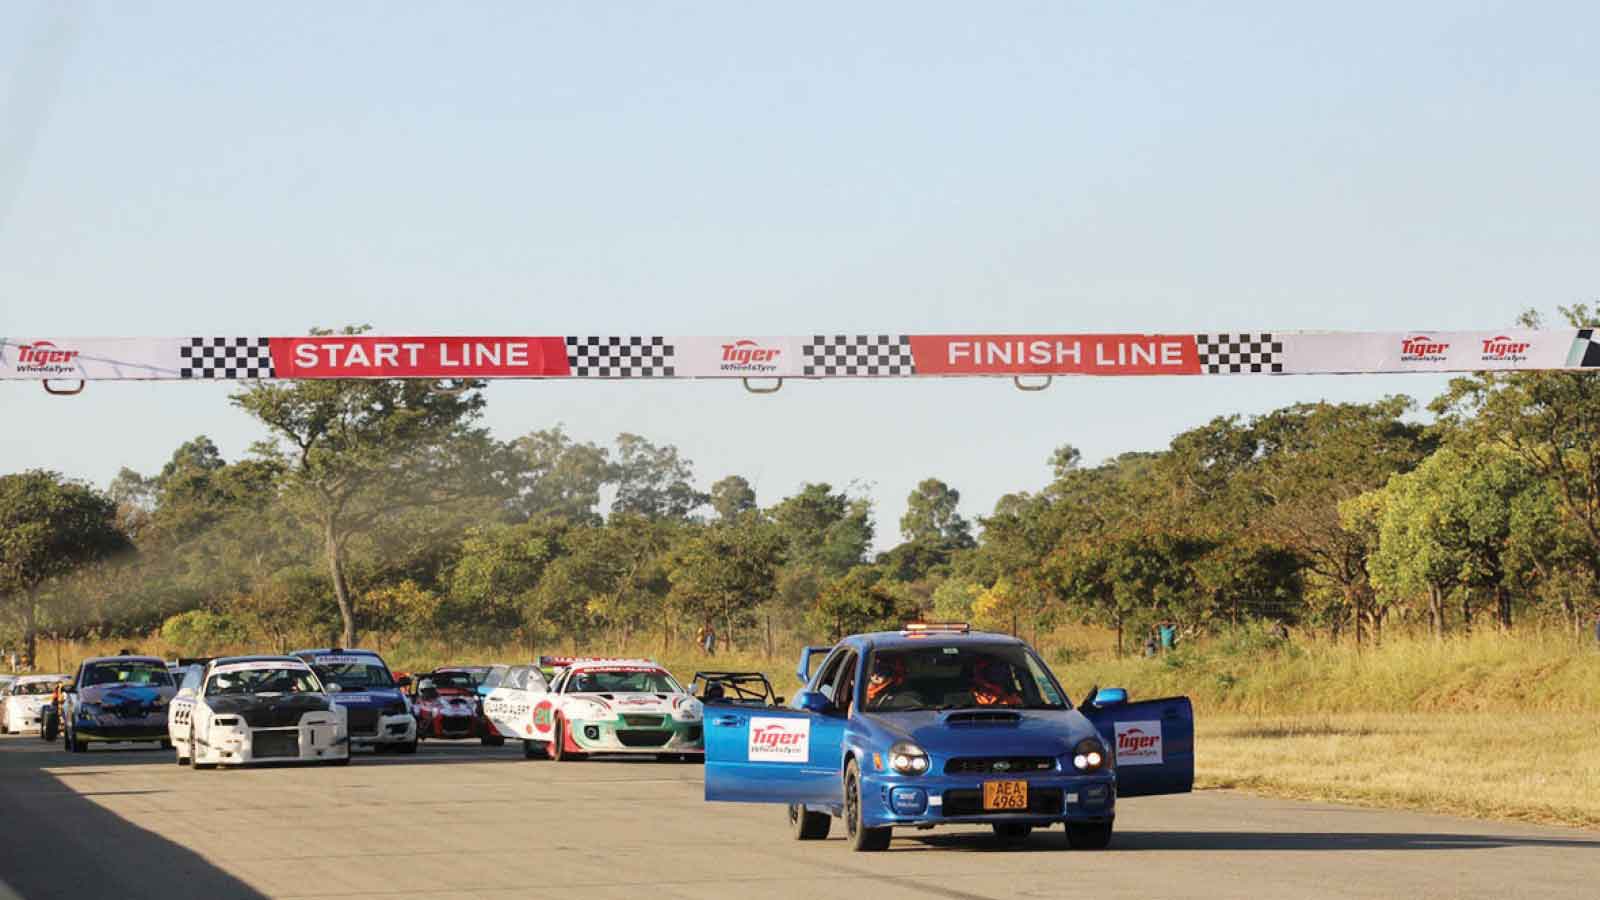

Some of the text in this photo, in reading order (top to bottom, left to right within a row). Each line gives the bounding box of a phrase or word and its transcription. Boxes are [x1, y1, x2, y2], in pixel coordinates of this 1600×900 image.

[18, 341, 79, 367] Tiger
[294, 343, 529, 368] START LINE
[721, 340, 781, 364] Tiger
[948, 340, 1183, 365] FINISH LINE
[1402, 336, 1450, 357] Tiger
[1482, 336, 1530, 357] Tiger
[753, 725, 806, 747] Tiger
[1119, 728, 1160, 751] Tiger
[996, 783, 1022, 795] AEA
[992, 795, 1025, 808] 4963
